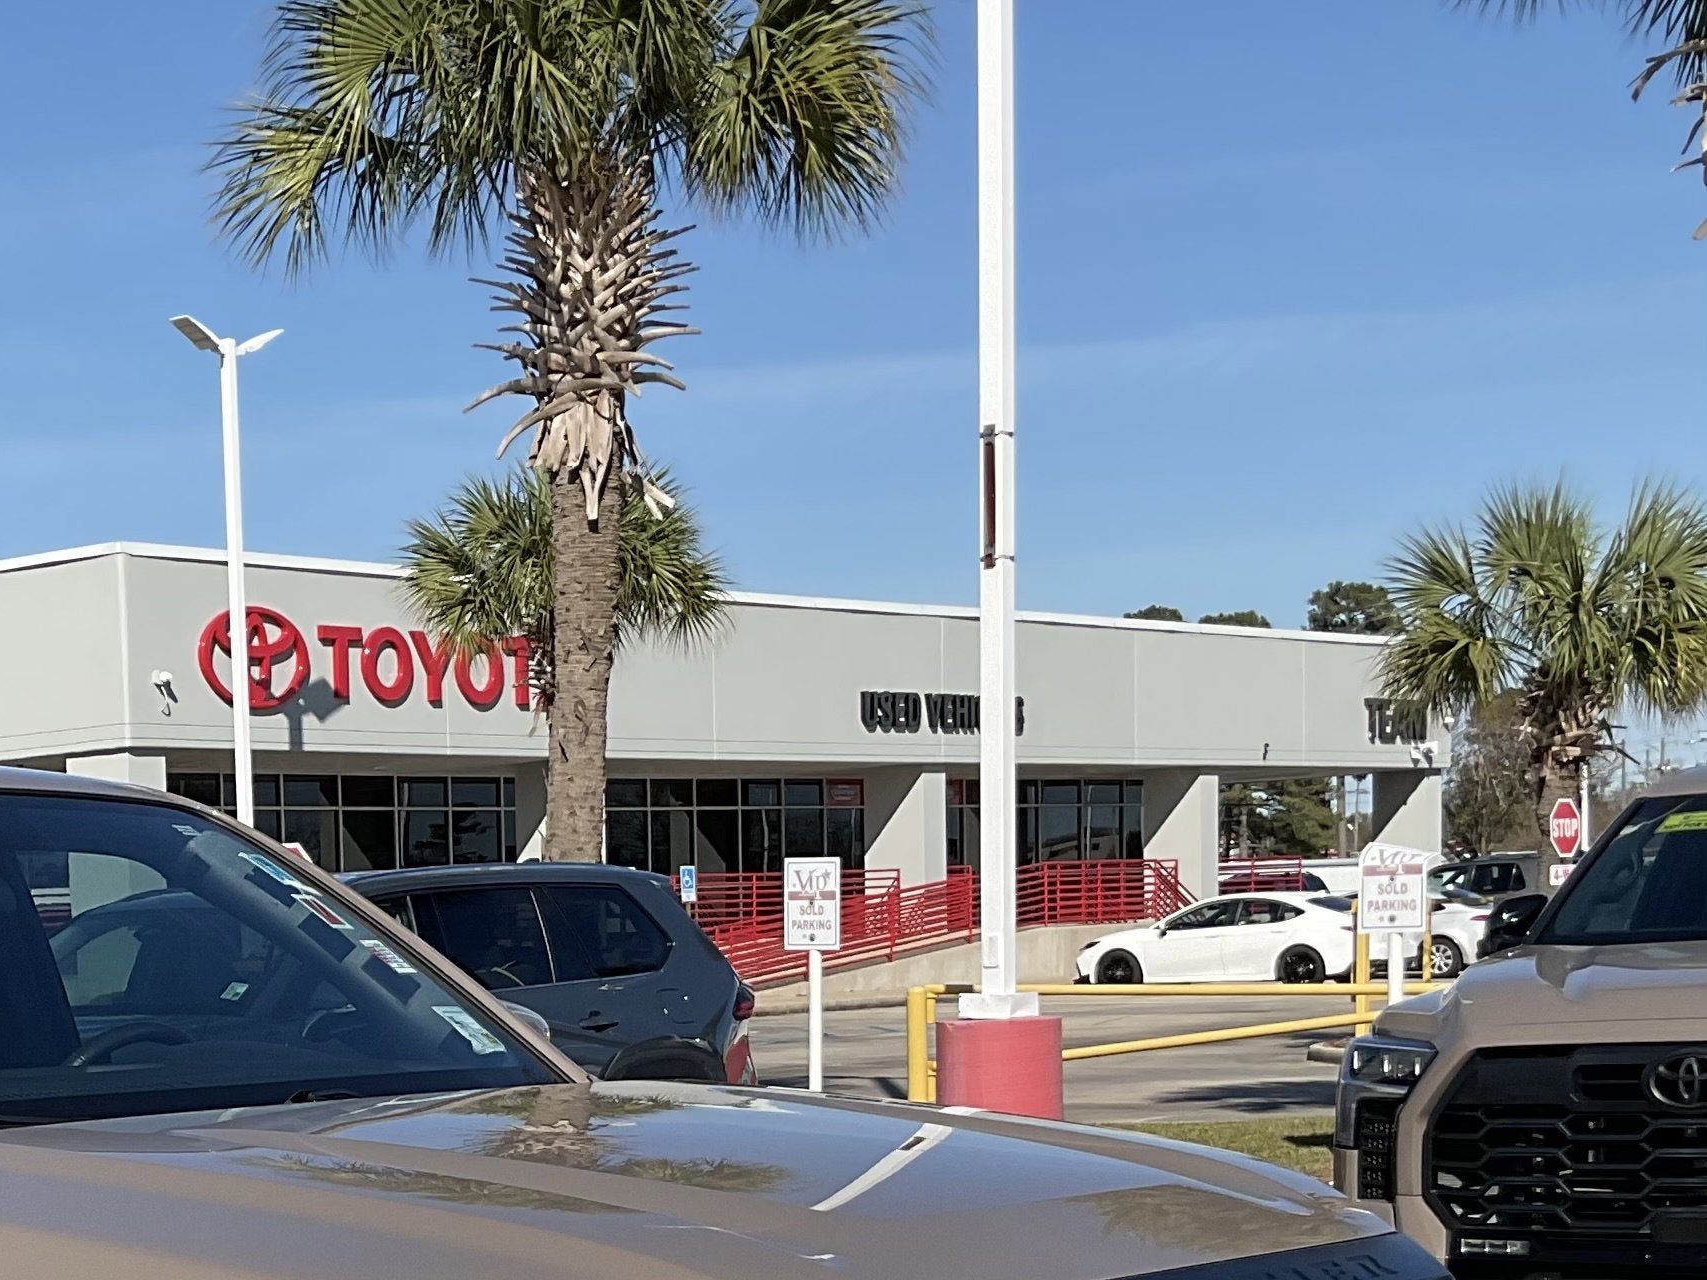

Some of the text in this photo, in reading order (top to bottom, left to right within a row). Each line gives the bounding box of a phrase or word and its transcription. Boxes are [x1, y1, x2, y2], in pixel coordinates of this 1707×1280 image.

[317, 625, 551, 711] TOYOT
[861, 690, 1024, 736] USED VEHIS
[1552, 818, 1578, 838] STOP
[1377, 883, 1408, 895] SOLD
[799, 905, 824, 915] SOLD
[1367, 900, 1417, 912] PARKING
[791, 919, 832, 930] PARKING
